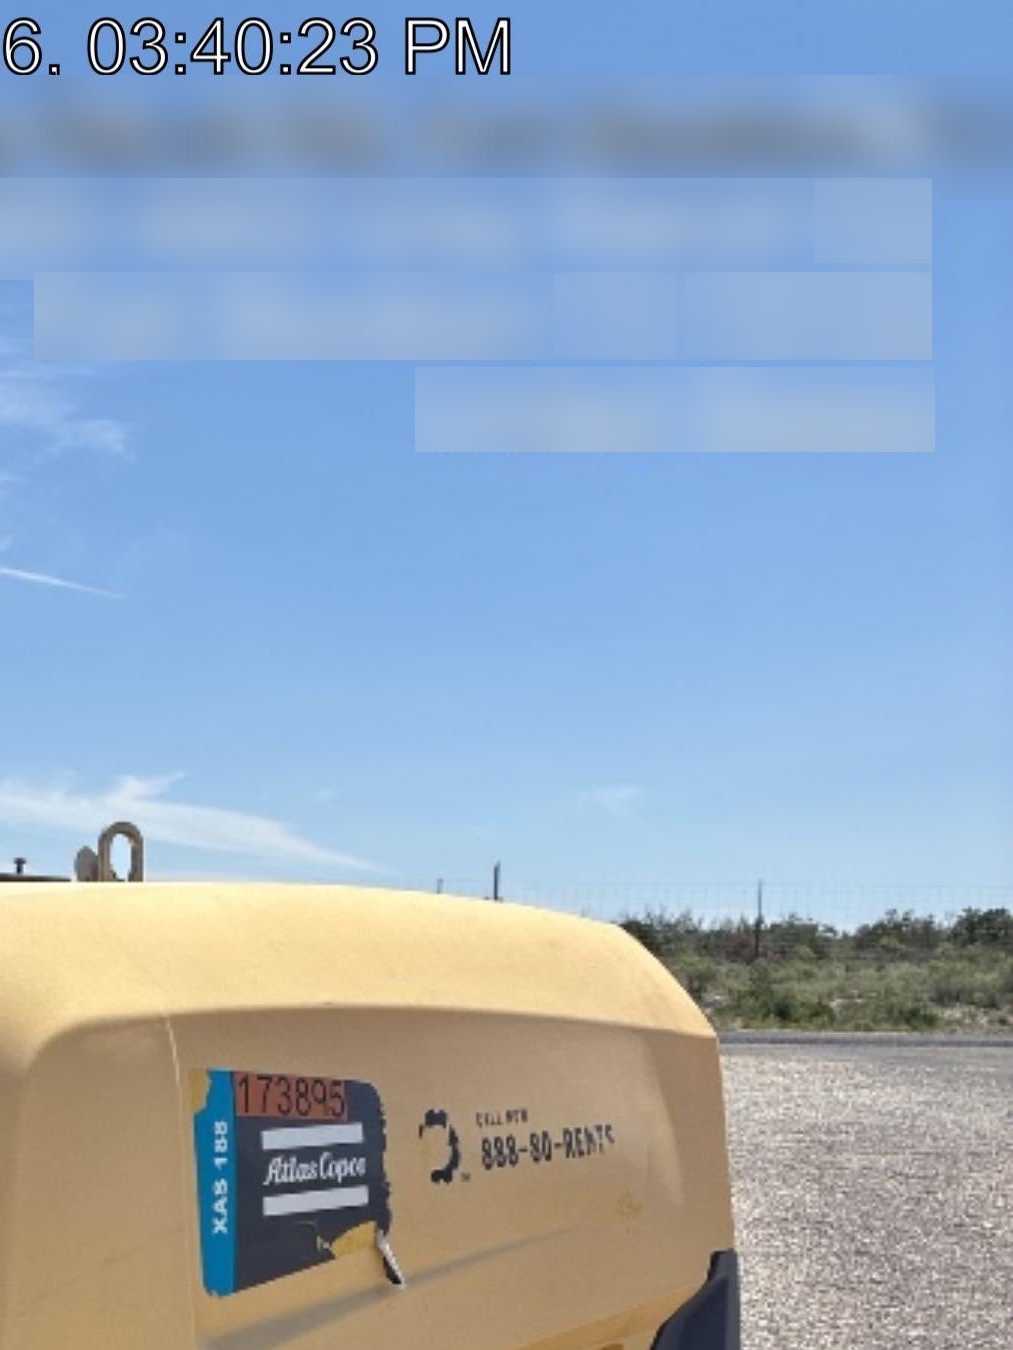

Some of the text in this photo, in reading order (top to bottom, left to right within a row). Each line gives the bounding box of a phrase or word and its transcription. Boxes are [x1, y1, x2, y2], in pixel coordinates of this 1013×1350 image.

[238, 1073, 346, 1117] 173895
[212, 1120, 228, 1235] XAS 188
[262, 1151, 366, 1186] Atlas Copco
